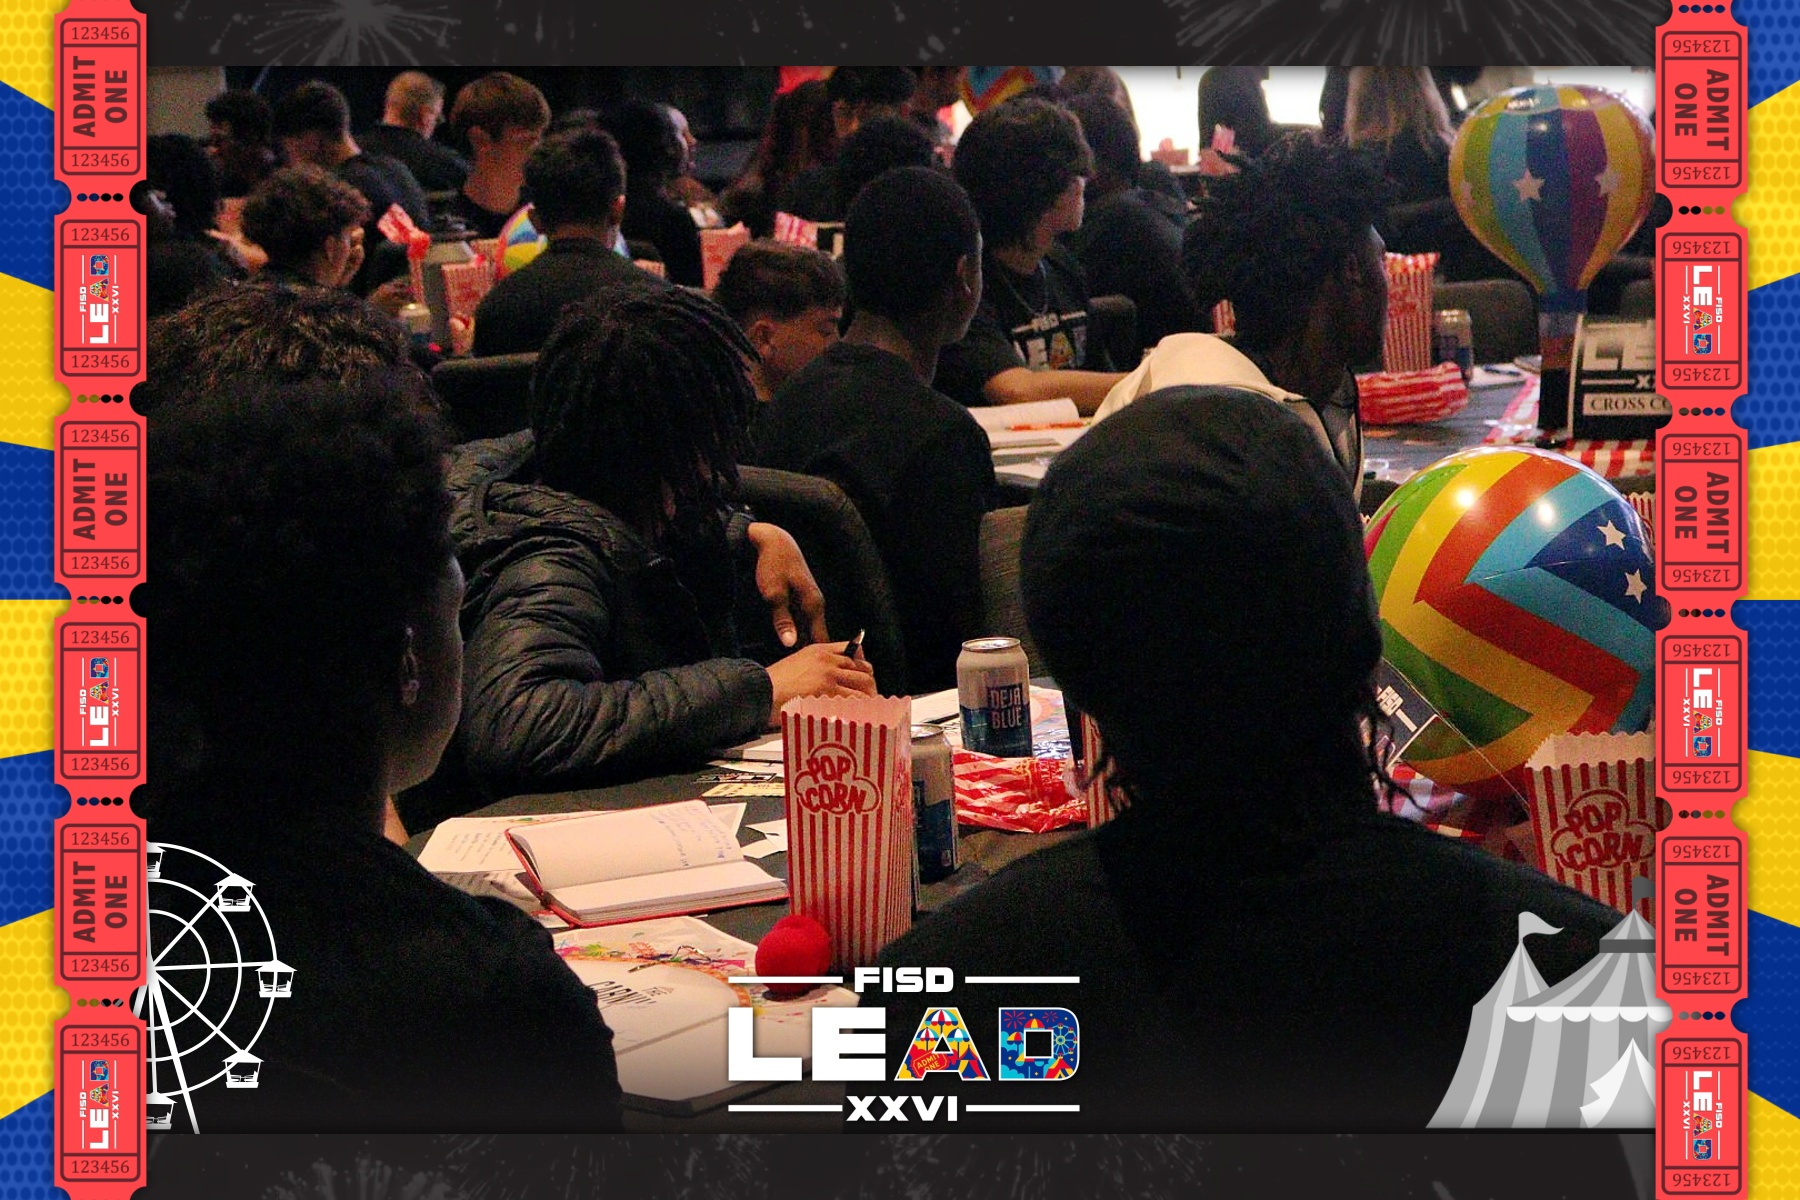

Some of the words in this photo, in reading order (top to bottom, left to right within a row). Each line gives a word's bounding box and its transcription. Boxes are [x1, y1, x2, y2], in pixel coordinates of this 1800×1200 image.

[1591, 397, 1645, 411] CROSS
[990, 687, 1022, 709] DEJA
[991, 706, 1022, 729] BLUE
[807, 755, 851, 784] POP
[802, 782, 867, 814] CORN
[1564, 801, 1622, 839] POP
[1565, 832, 1643, 872] CORN
